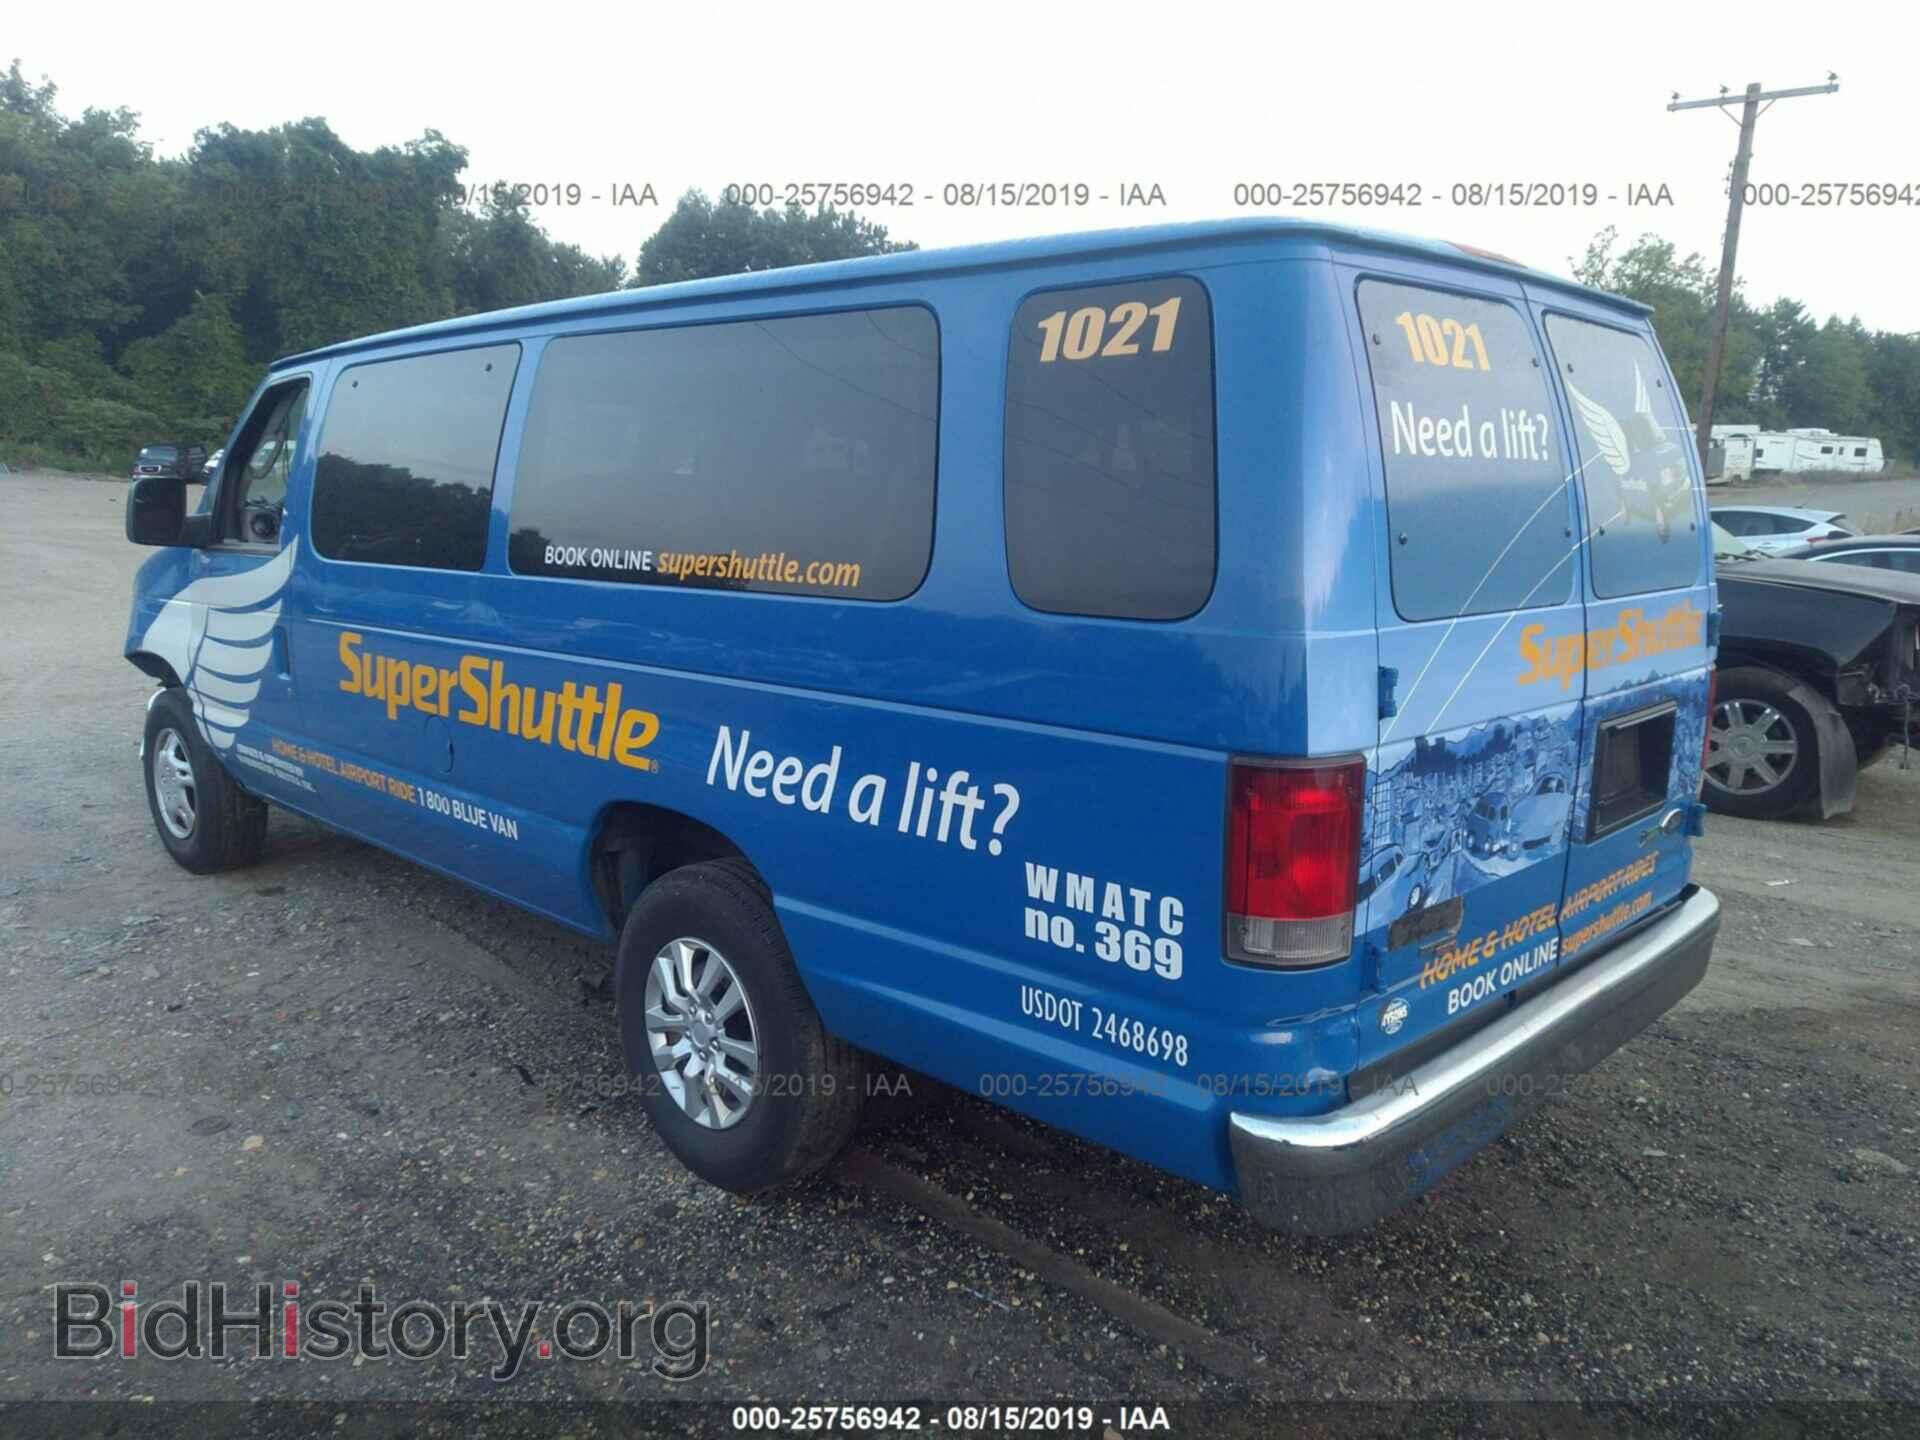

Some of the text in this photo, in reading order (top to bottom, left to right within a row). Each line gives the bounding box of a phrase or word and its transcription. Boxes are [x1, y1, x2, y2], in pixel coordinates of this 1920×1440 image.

[1038, 296, 1182, 363] 1021
[1395, 311, 1491, 371] 1021
[1390, 400, 1549, 461] Need a lift?
[544, 545, 862, 588] BOOK ONLINE supershuttle.com
[1516, 597, 1704, 692] SuperShuttle
[338, 630, 660, 772] SuperShuttle
[387, 776, 417, 805] RIDE
[452, 799, 488, 830] BLUE
[488, 811, 519, 841] VAN
[706, 724, 1021, 857] Need a lift?
[1024, 906, 1184, 981] no. 369
[1418, 937, 1483, 991] HOME
[1500, 902, 1558, 950] HOTEL
[1447, 967, 1499, 1016] BOOK
[1500, 936, 1560, 987] ONLINE
[1021, 984, 1189, 1068] USDOT 2468698
